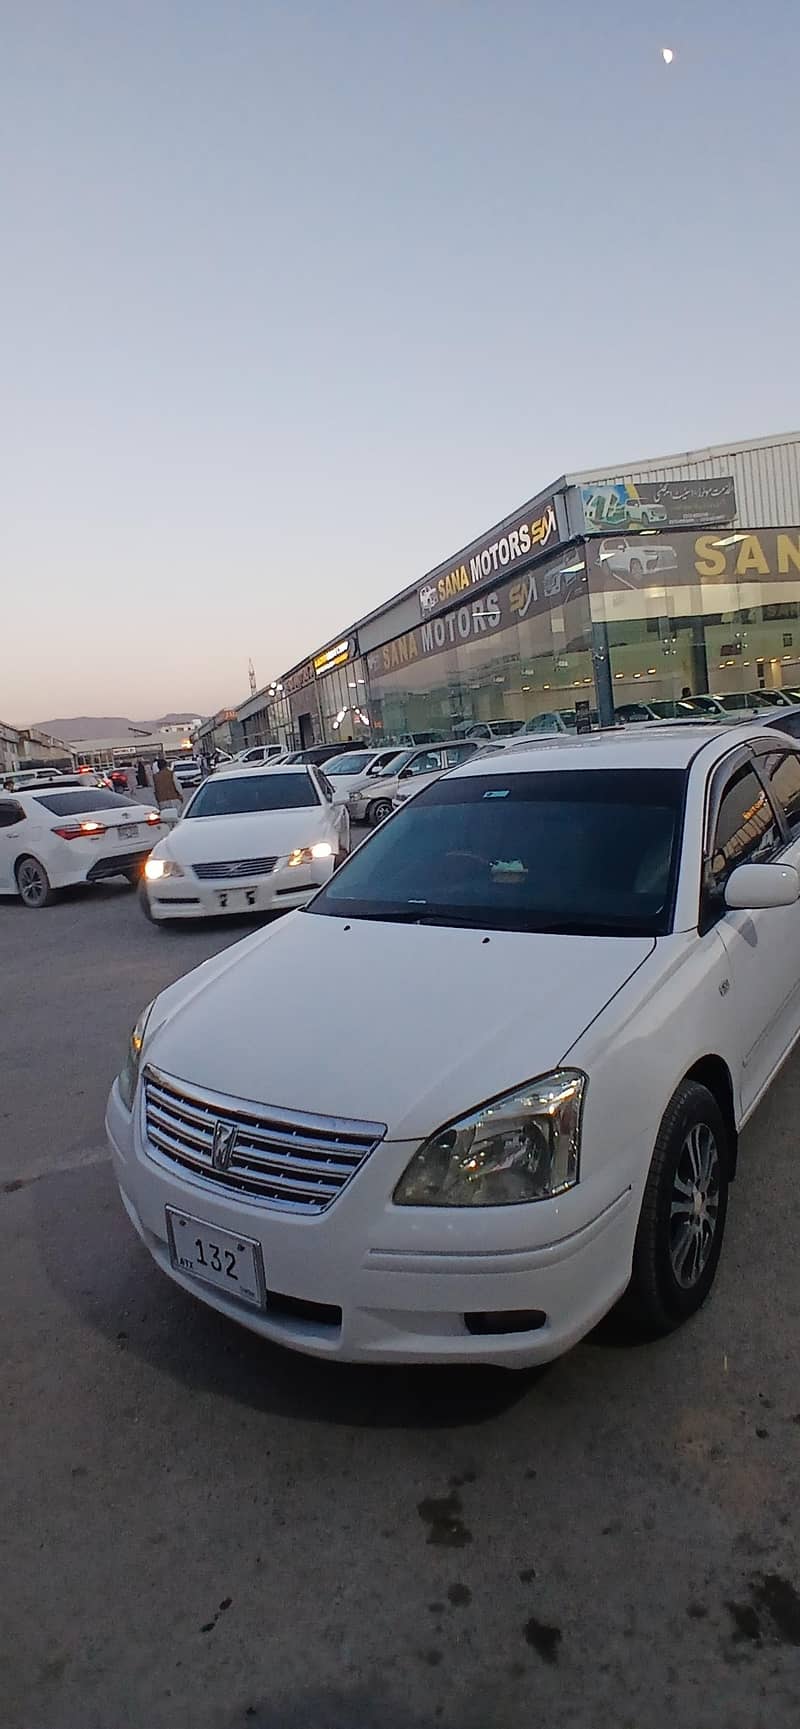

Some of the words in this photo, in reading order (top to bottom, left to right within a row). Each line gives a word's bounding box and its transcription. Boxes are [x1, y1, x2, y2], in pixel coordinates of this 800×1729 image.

[437, 565, 470, 600] SANA
[469, 524, 532, 583] MOTORS
[382, 634, 418, 669] SANA
[421, 593, 501, 652] MOTORS
[194, 1238, 239, 1281] 132
